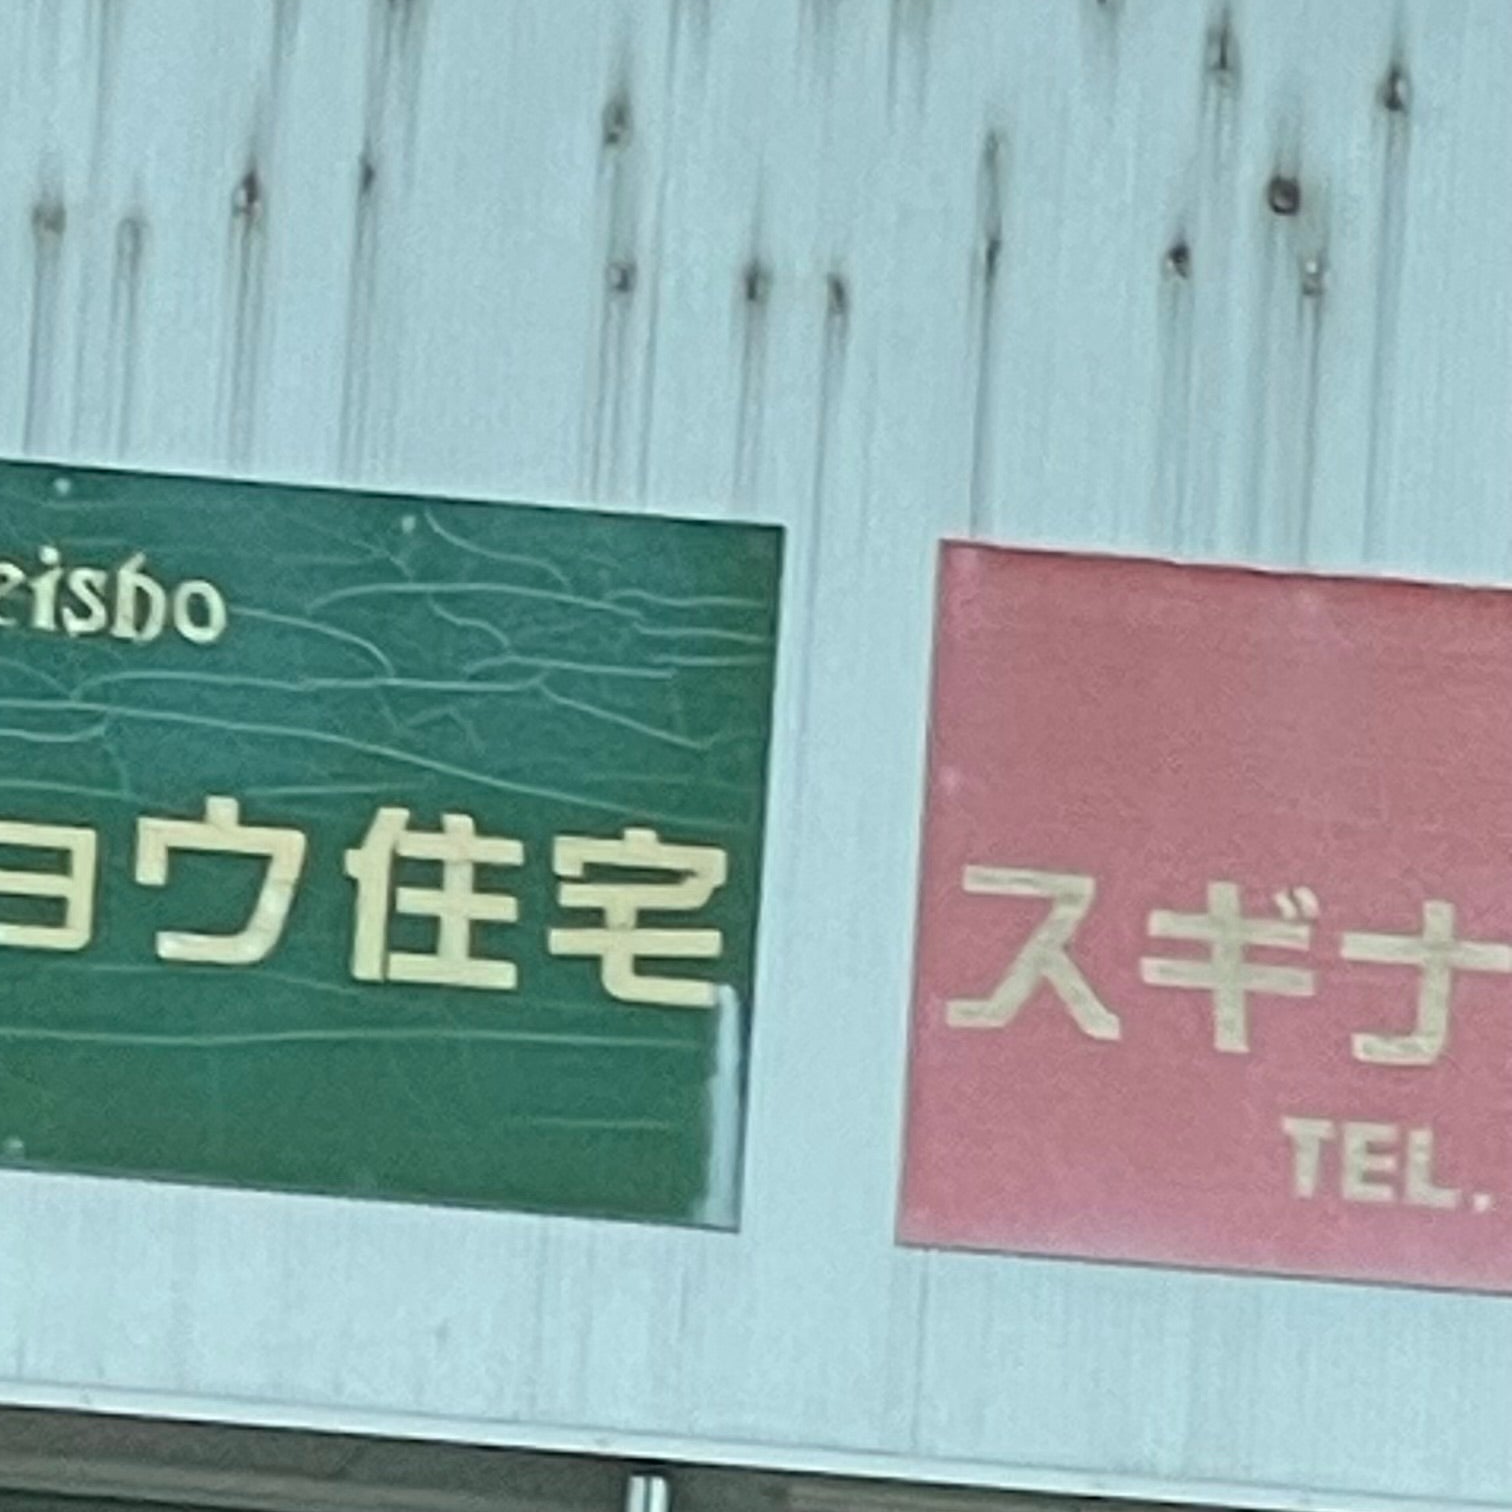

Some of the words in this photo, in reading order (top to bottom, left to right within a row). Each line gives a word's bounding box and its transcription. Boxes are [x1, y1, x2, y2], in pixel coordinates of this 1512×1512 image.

[945, 864, 1512, 1066] スギナ
[1282, 1115, 1491, 1214] TEL.
